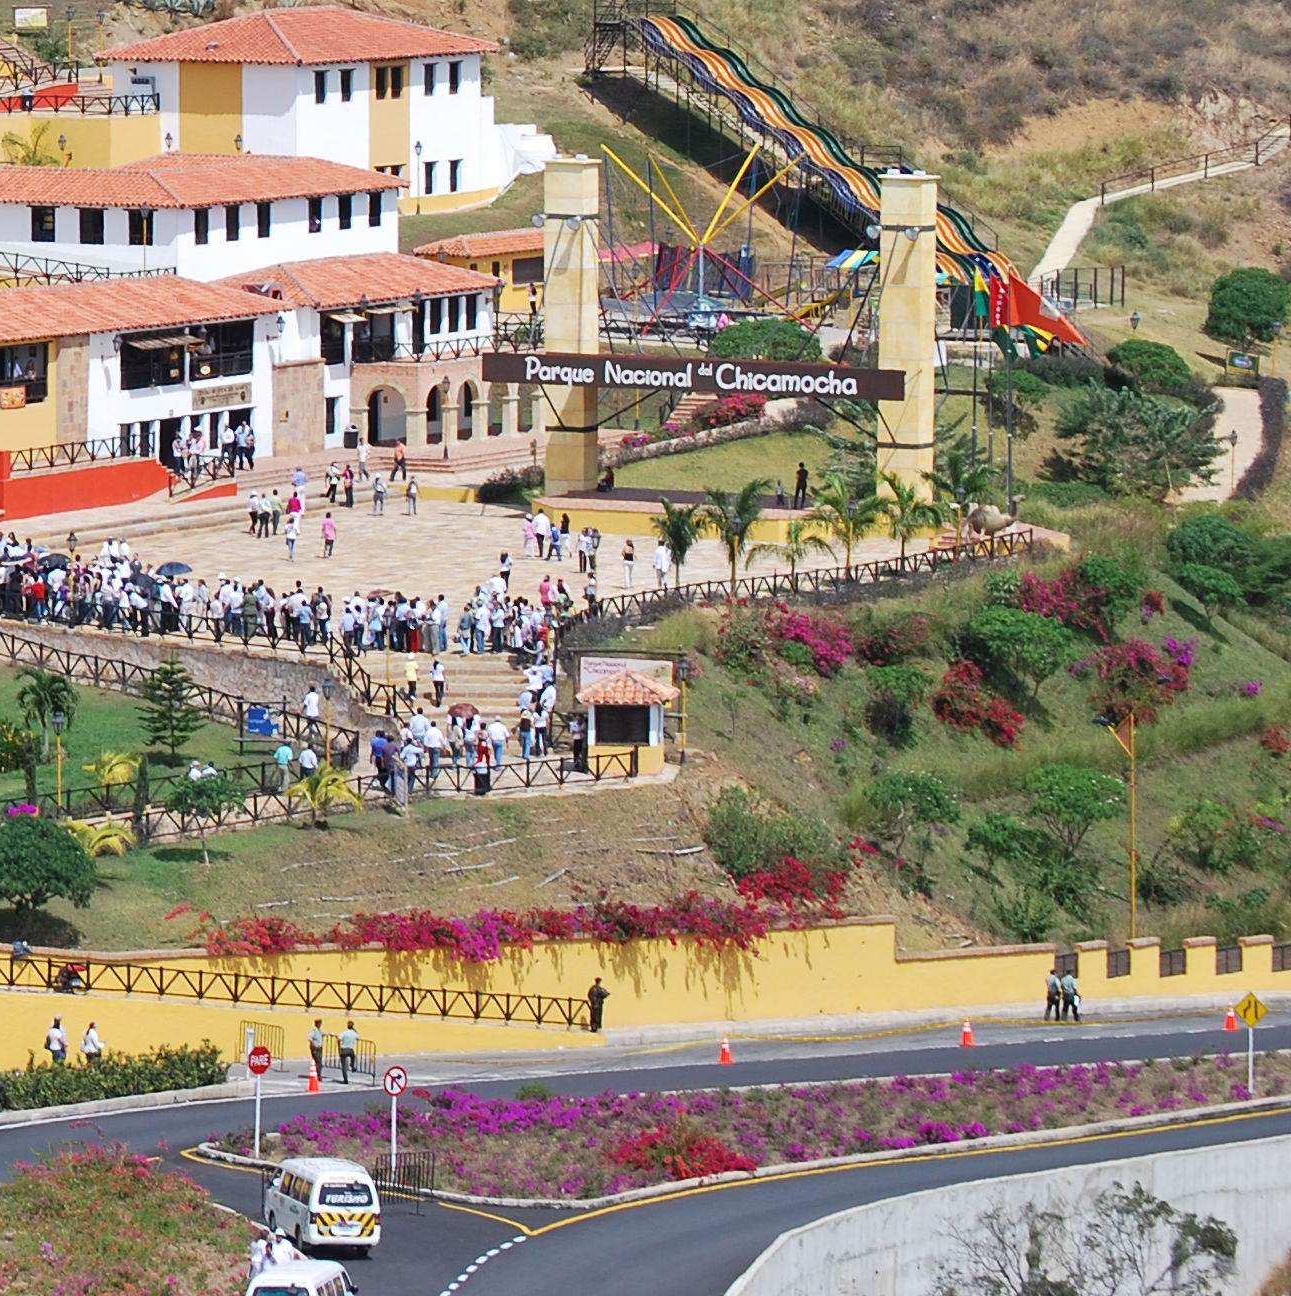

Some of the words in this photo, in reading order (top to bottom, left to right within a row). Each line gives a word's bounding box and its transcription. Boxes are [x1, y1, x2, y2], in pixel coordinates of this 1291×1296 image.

[525, 355, 595, 385] Parque
[604, 360, 692, 388] Nacional
[698, 363, 714, 377] del
[716, 363, 858, 396] Chicamocha
[250, 1054, 269, 1066] PARE
